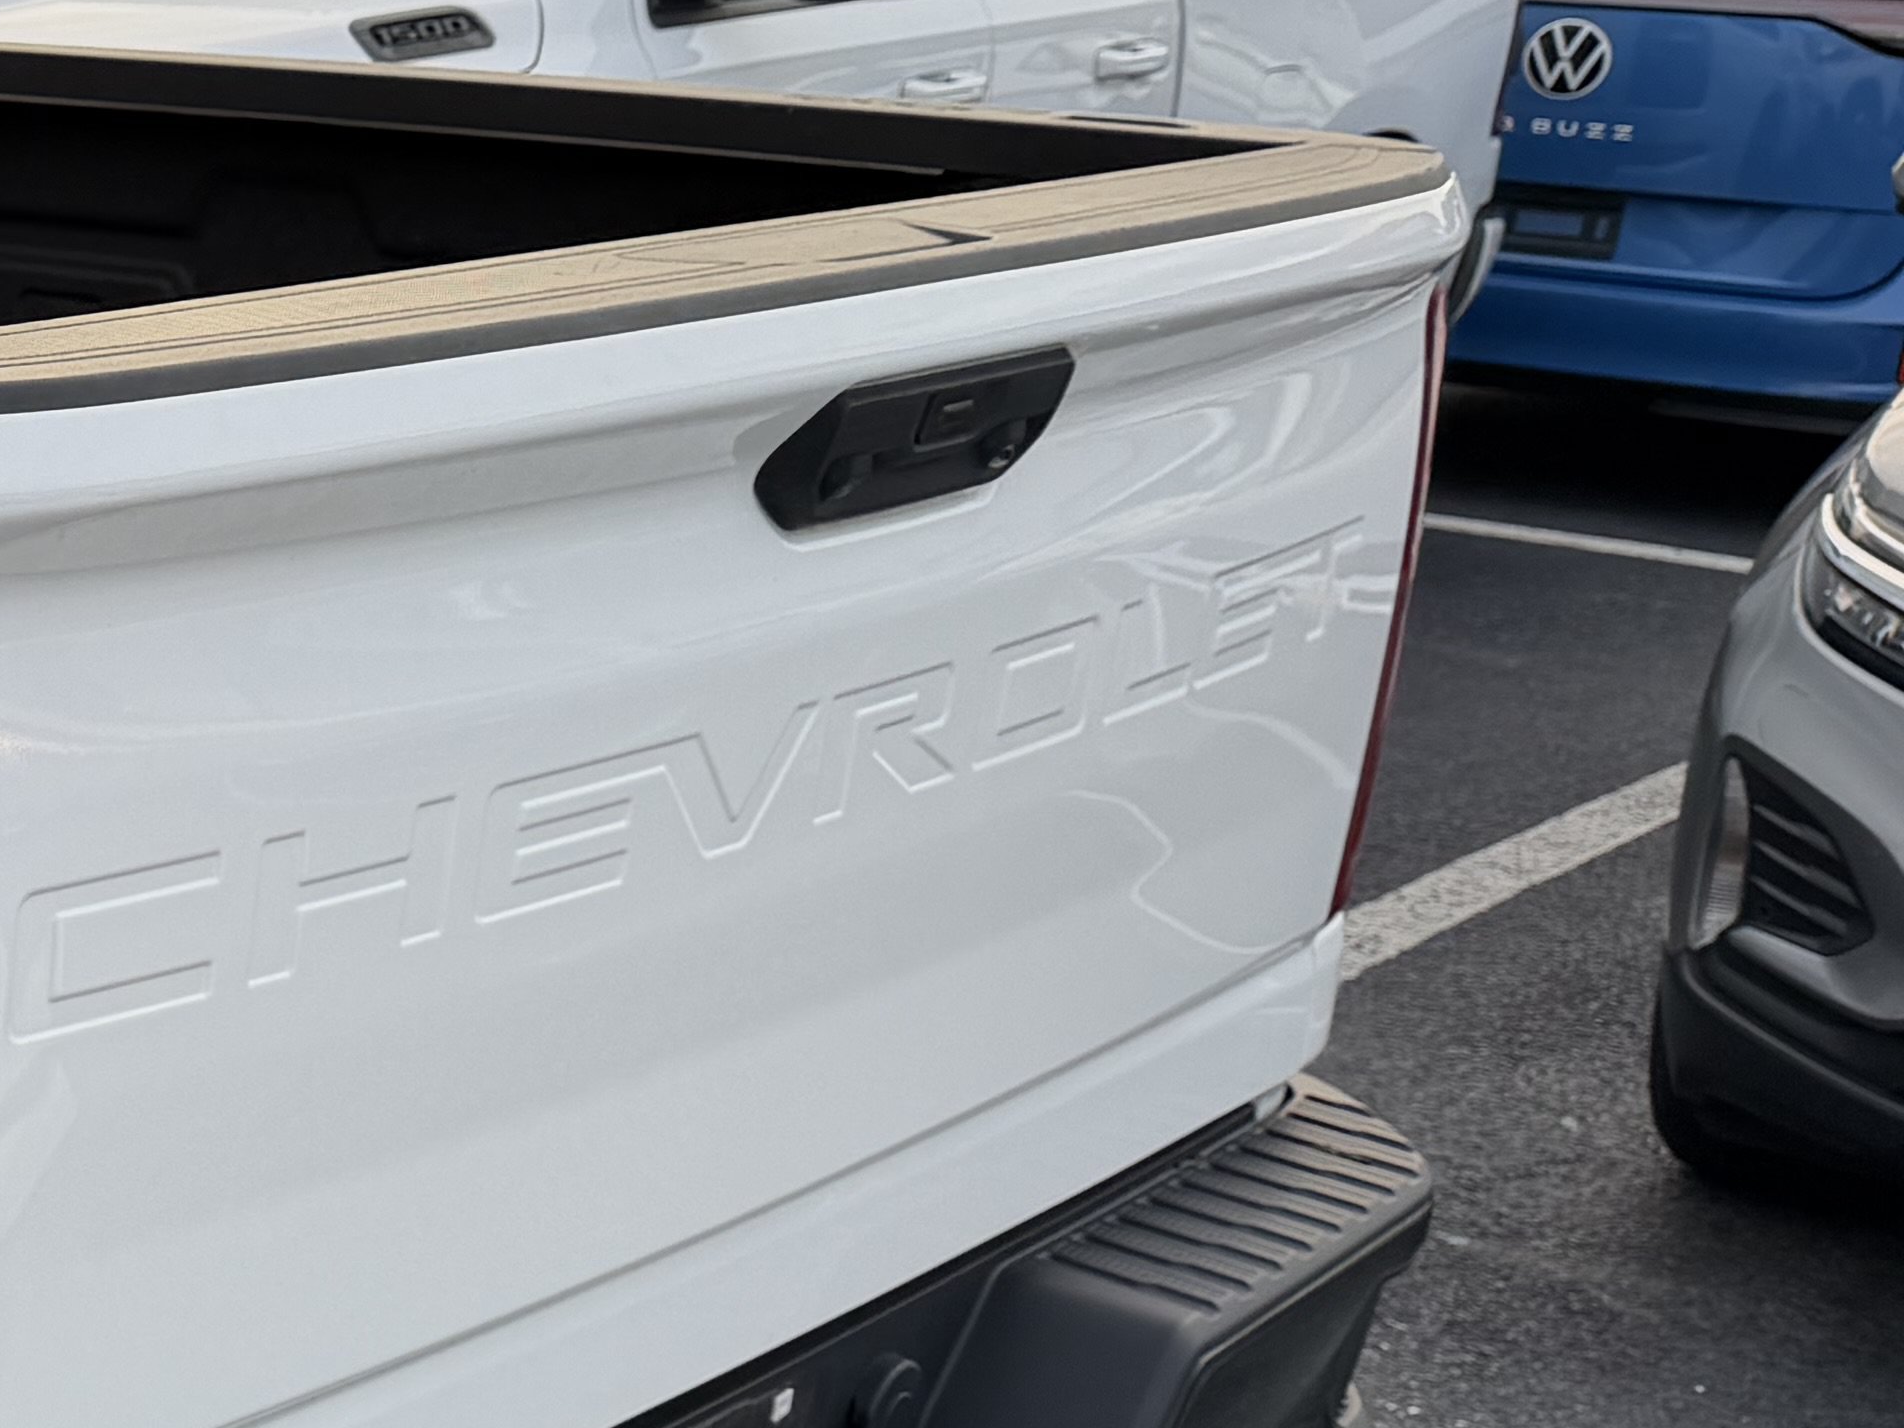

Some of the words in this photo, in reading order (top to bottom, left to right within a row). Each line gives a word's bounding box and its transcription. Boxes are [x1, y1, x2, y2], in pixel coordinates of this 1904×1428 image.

[375, 15, 470, 47] 1500
[1525, 19, 1611, 97] VW
[1530, 117, 1634, 142] BUZZ
[4, 515, 1366, 1044] CHEVROLET
